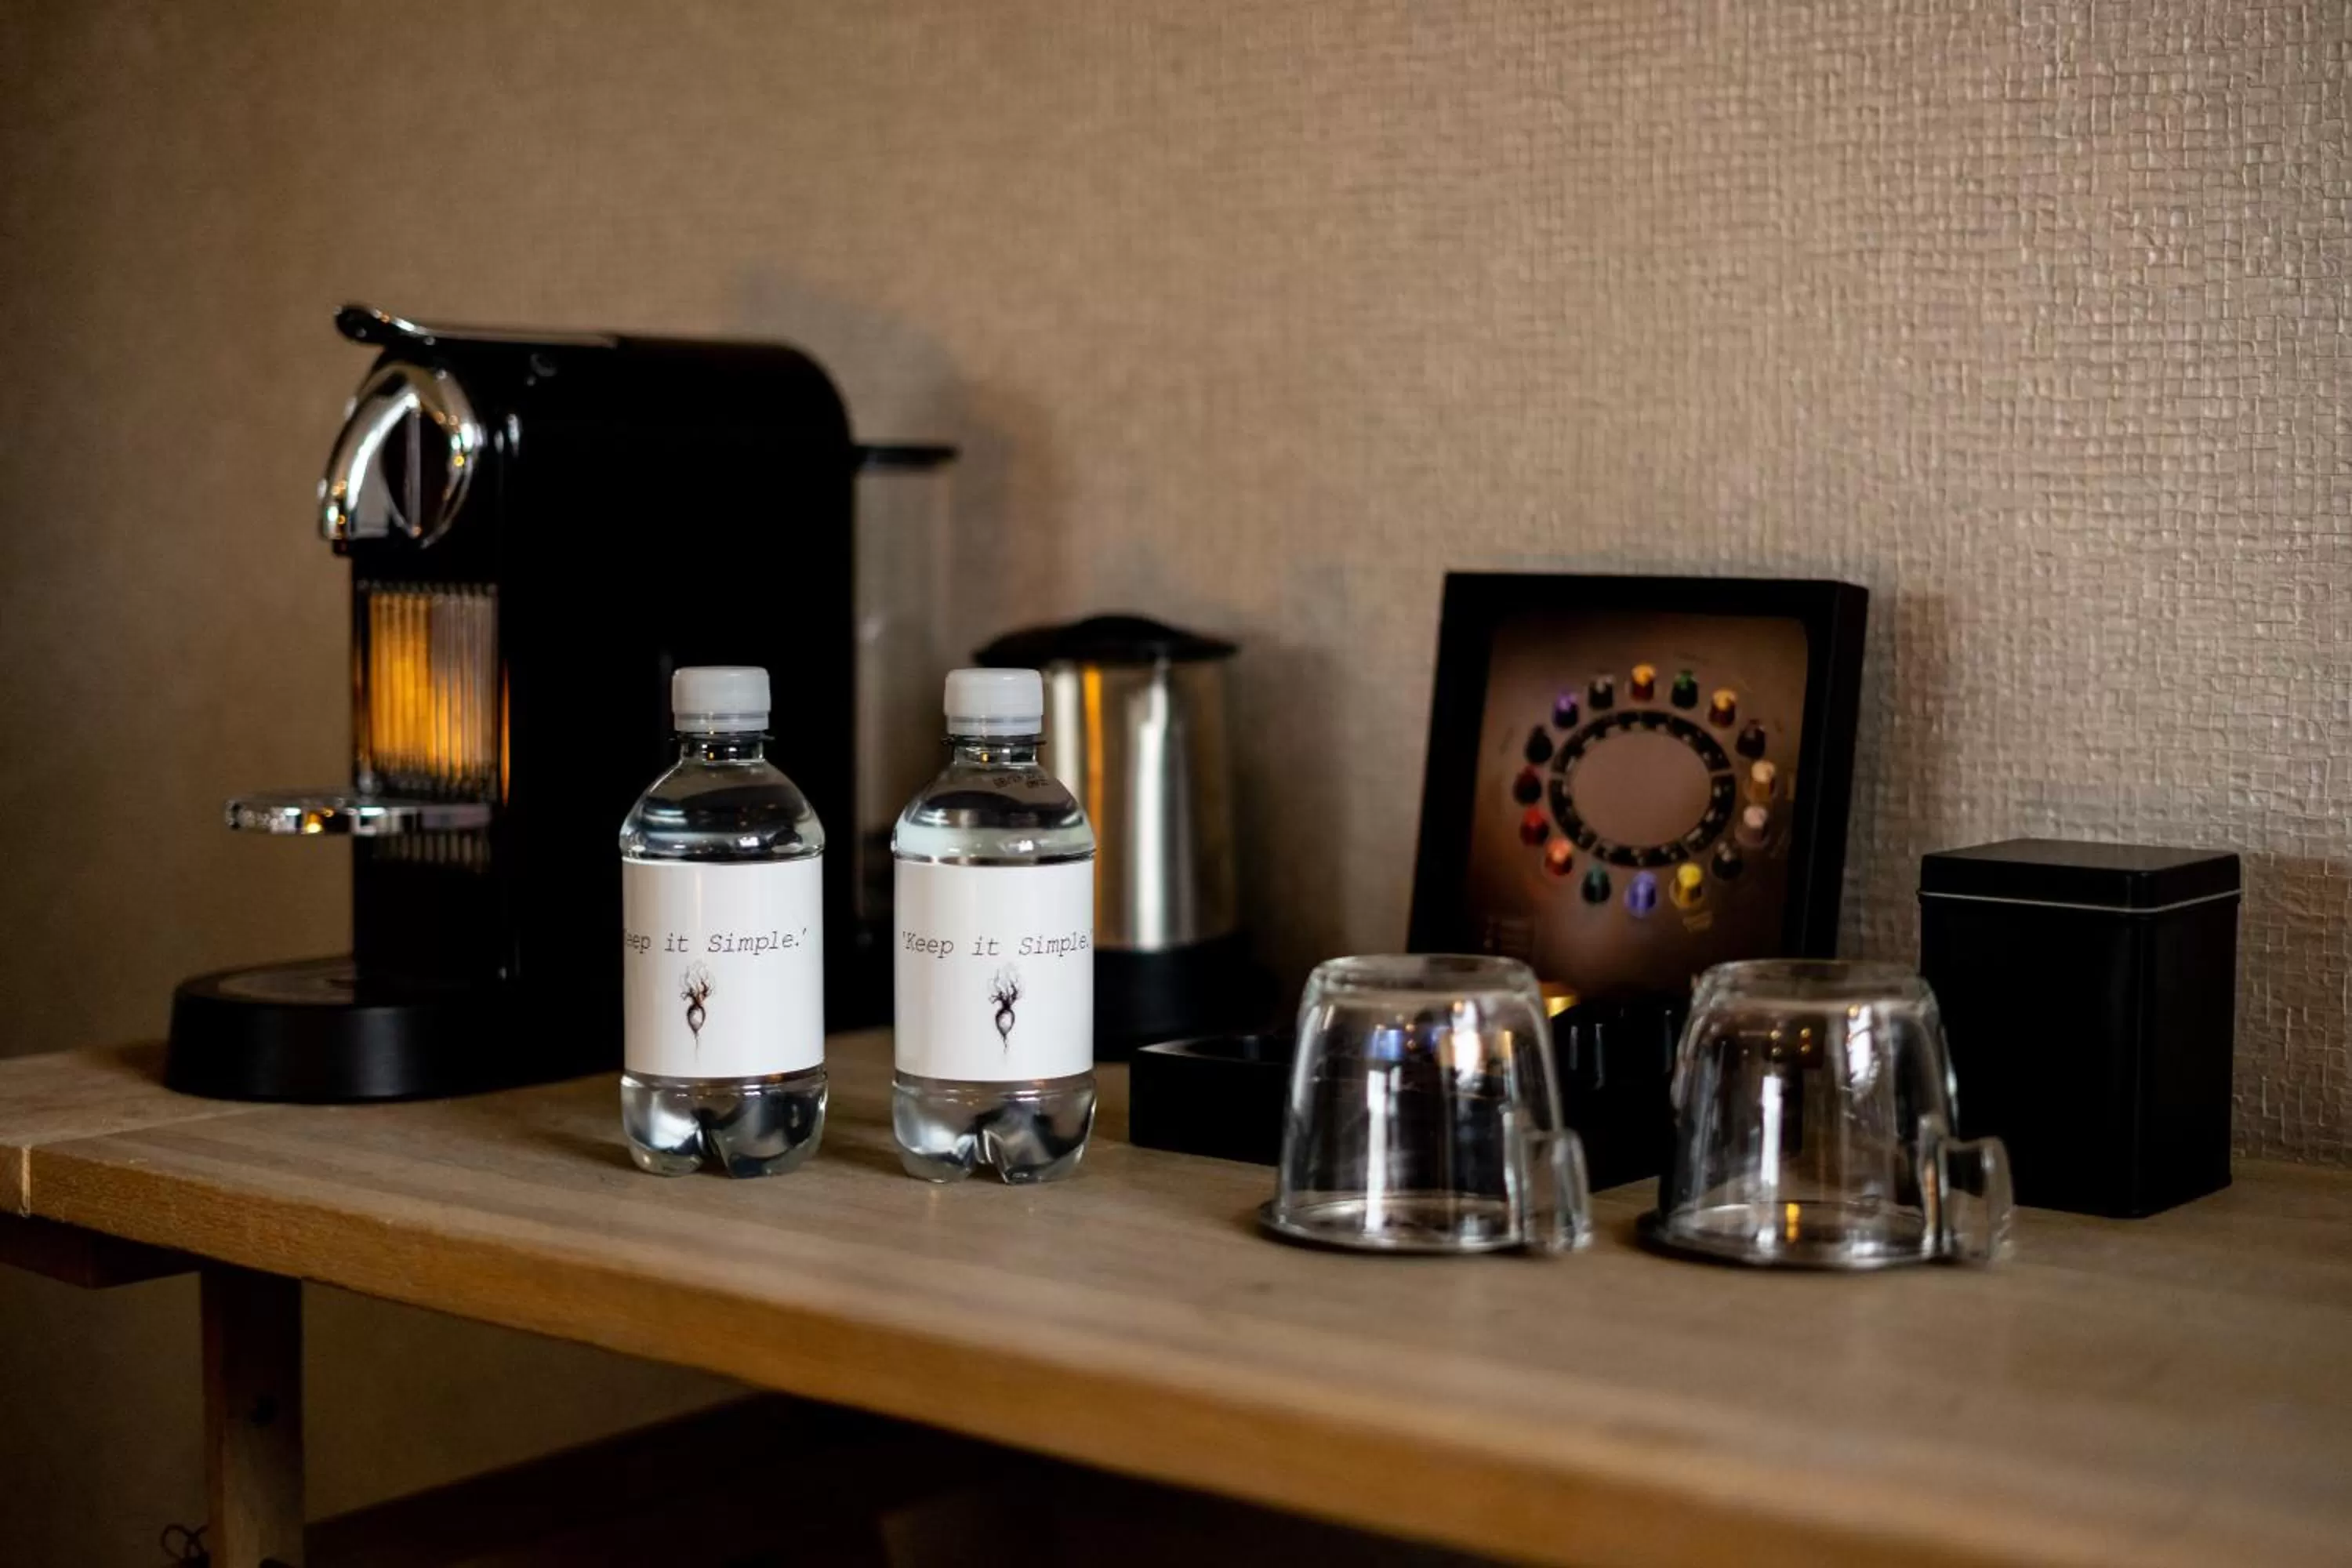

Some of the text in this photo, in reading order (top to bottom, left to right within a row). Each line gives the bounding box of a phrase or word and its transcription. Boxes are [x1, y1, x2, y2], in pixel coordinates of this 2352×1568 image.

[664, 932, 690, 953] it
[707, 927, 807, 956] Simple.'
[971, 936, 1000, 956] it
